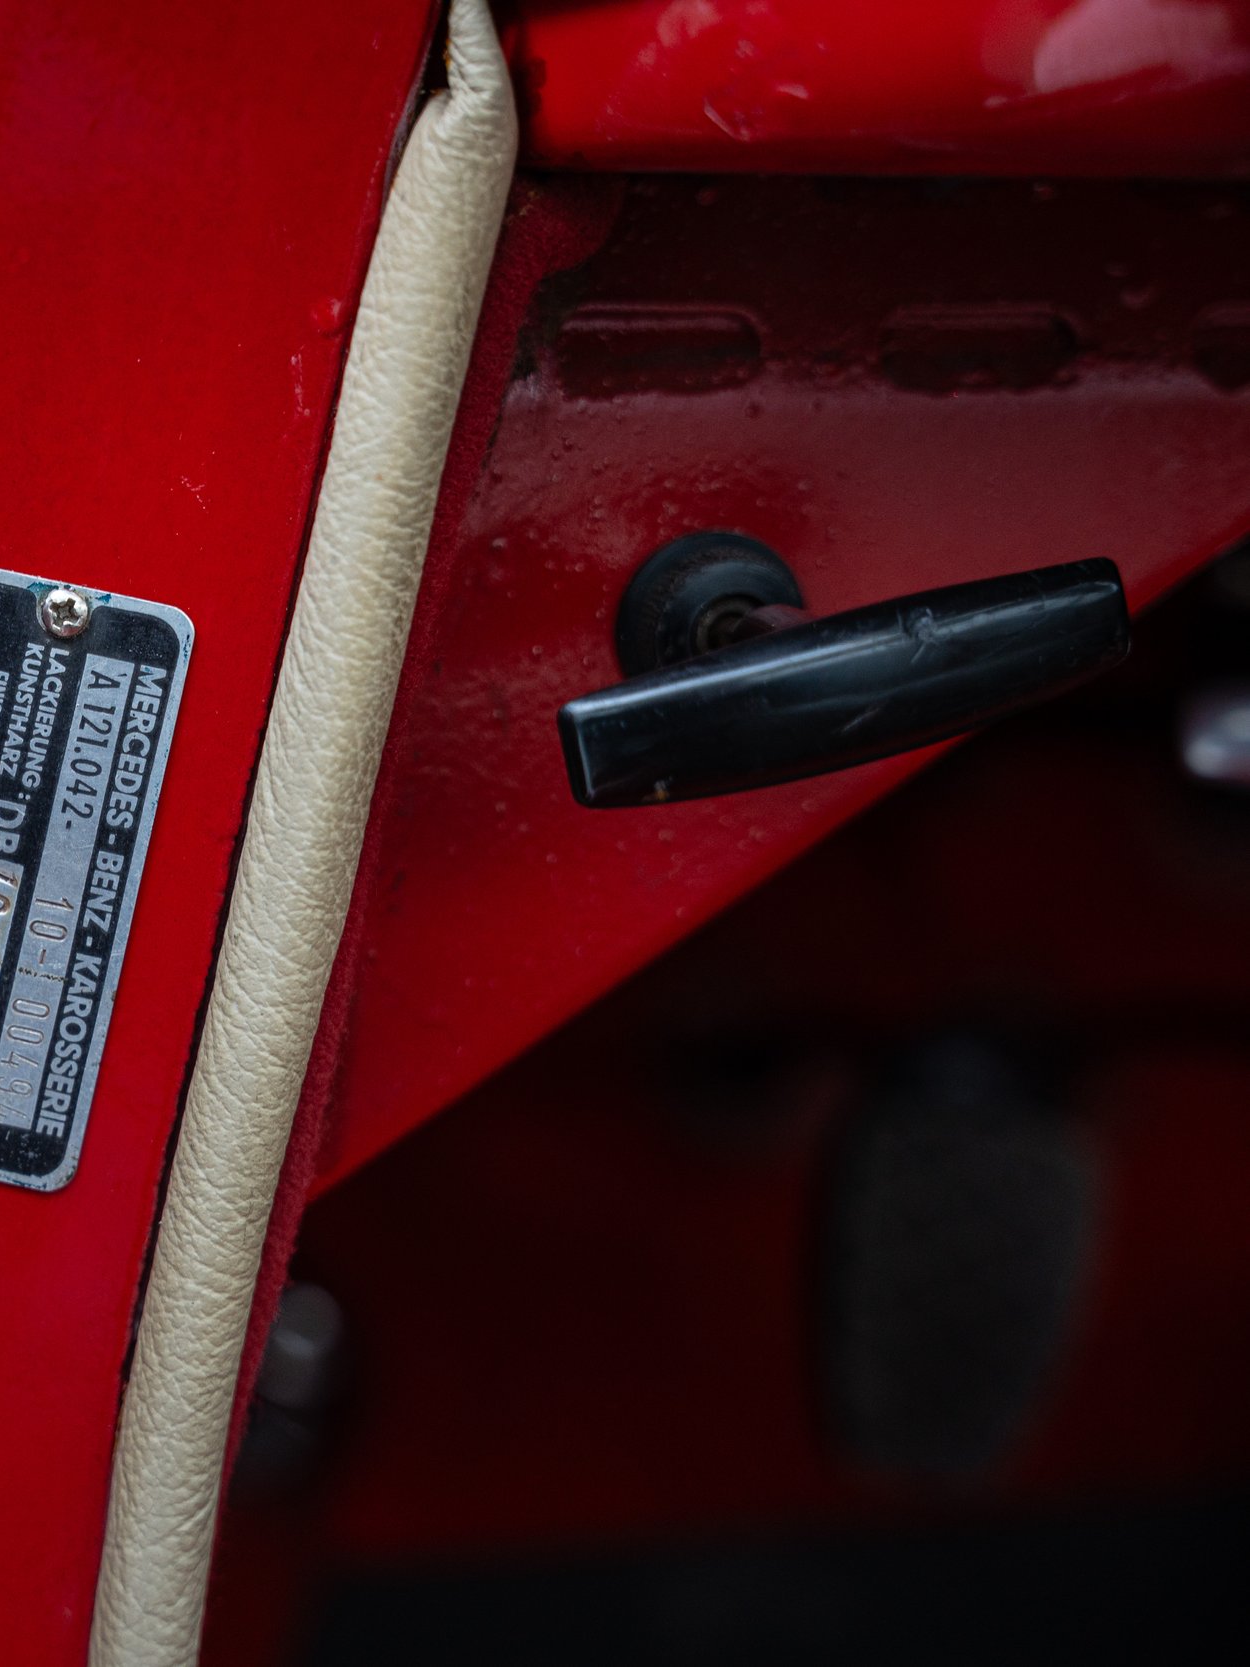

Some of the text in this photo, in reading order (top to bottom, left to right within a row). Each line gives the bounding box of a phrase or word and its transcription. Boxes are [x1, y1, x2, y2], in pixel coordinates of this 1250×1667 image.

[105, 664, 166, 829] MERCEDES
[82, 850, 124, 932] BENZ
[35, 952, 101, 1137] KAROSSERIE
